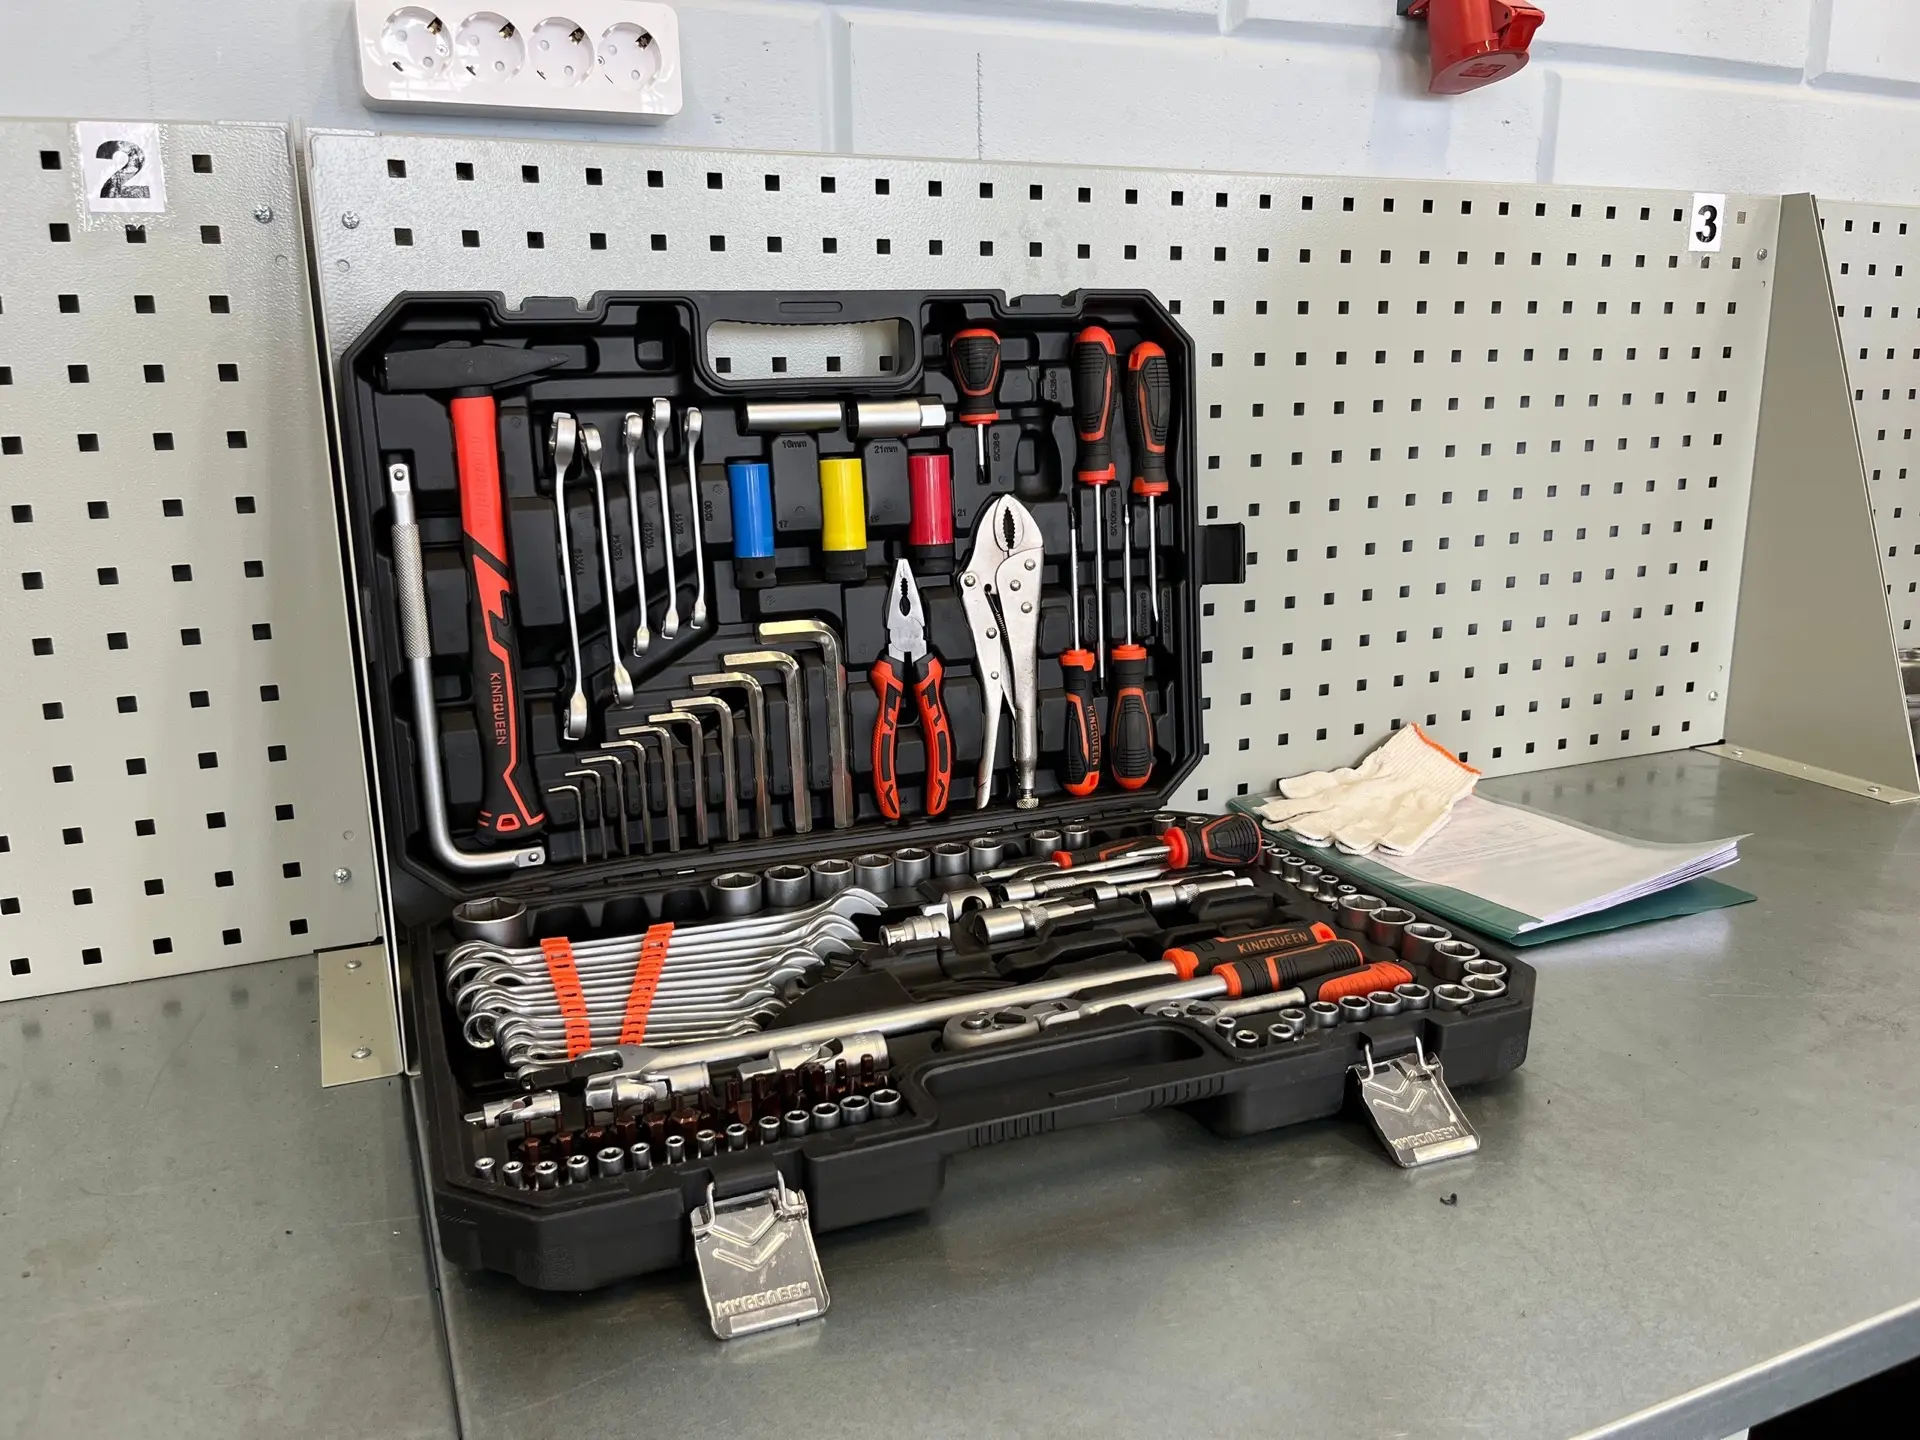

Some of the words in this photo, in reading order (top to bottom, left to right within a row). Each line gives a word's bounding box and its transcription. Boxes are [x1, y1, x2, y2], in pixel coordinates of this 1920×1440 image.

[95, 140, 151, 199] 2
[1695, 204, 1718, 243] 3
[489, 672, 508, 745] KINGQUEEN
[1087, 705, 1099, 766] KINGQUEEN
[1237, 931, 1309, 954] KINGQUEEN
